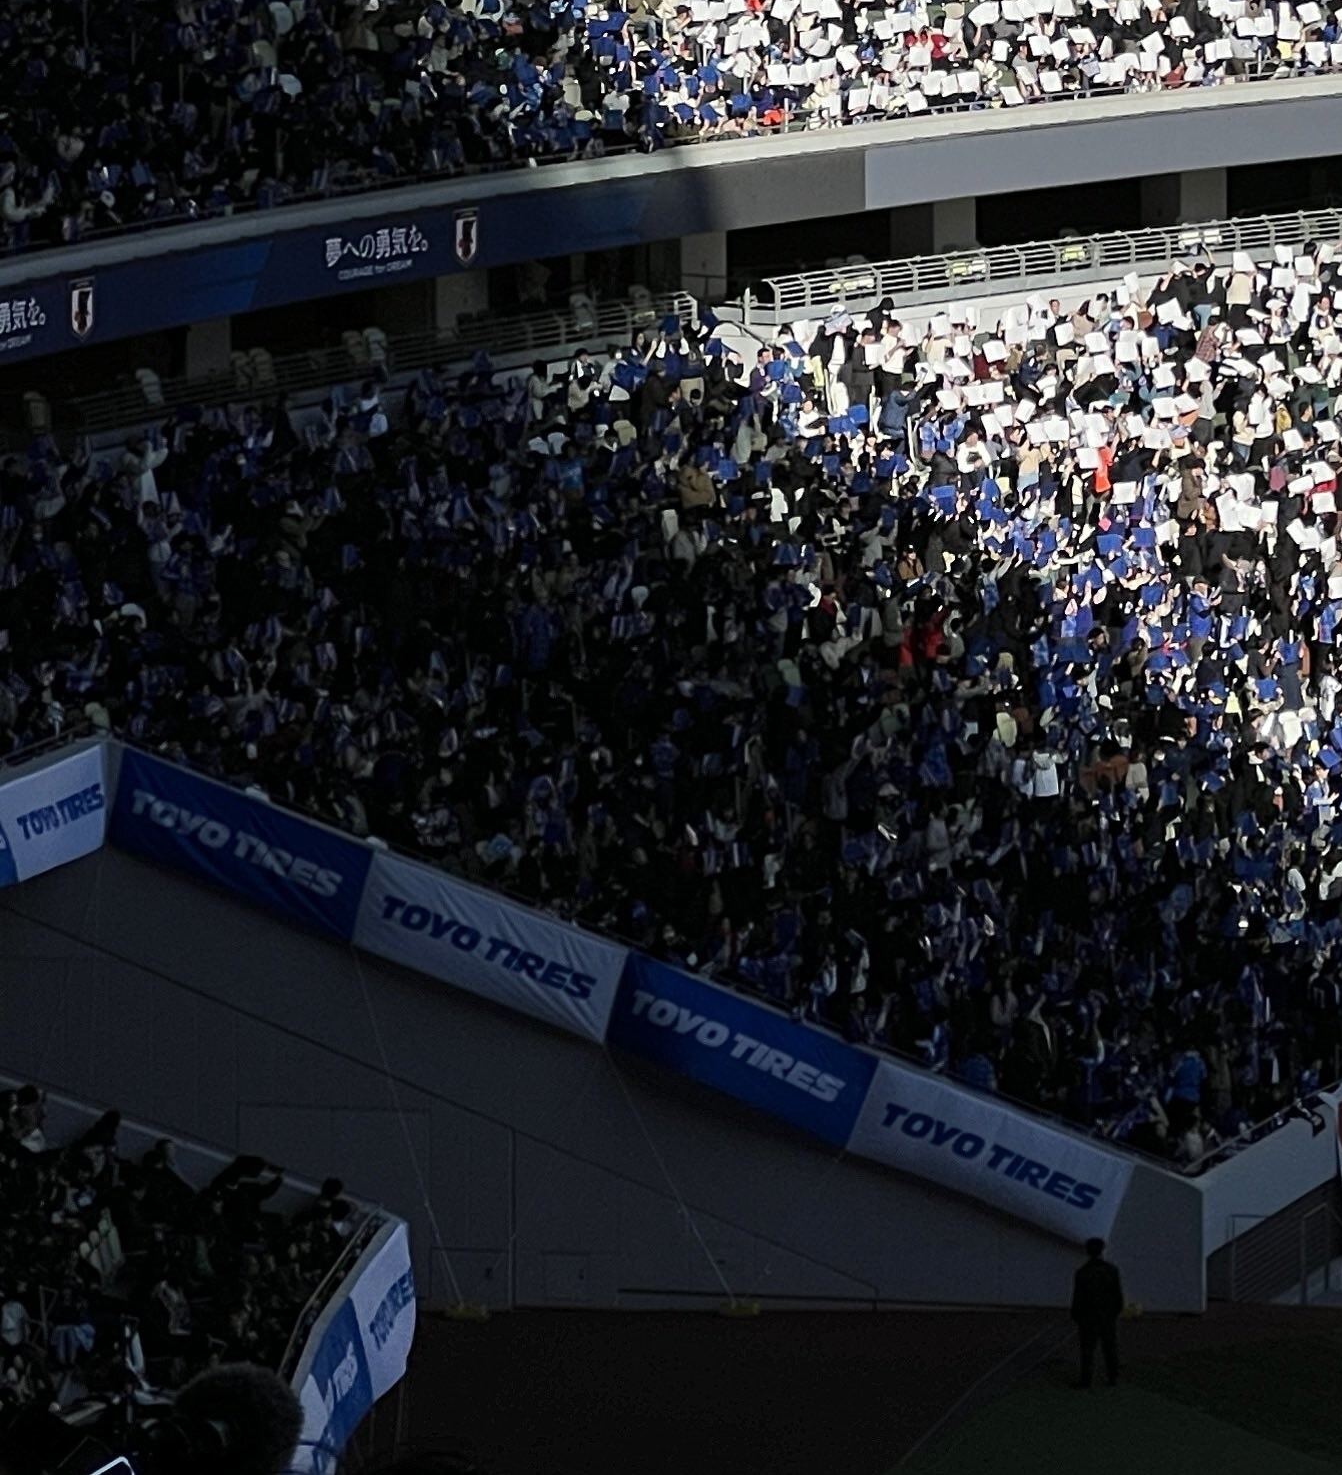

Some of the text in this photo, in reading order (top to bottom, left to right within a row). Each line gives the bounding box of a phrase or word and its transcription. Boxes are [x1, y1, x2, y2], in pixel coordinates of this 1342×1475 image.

[325, 224, 429, 268] 夢への勇気を。
[55, 783, 104, 826] TIRES
[132, 788, 344, 898] TOYO TIRES
[381, 895, 598, 1001] TOYO TIRES
[631, 988, 847, 1103] TOYO TIRES
[880, 1102, 1103, 1210] TOYO TIRES
